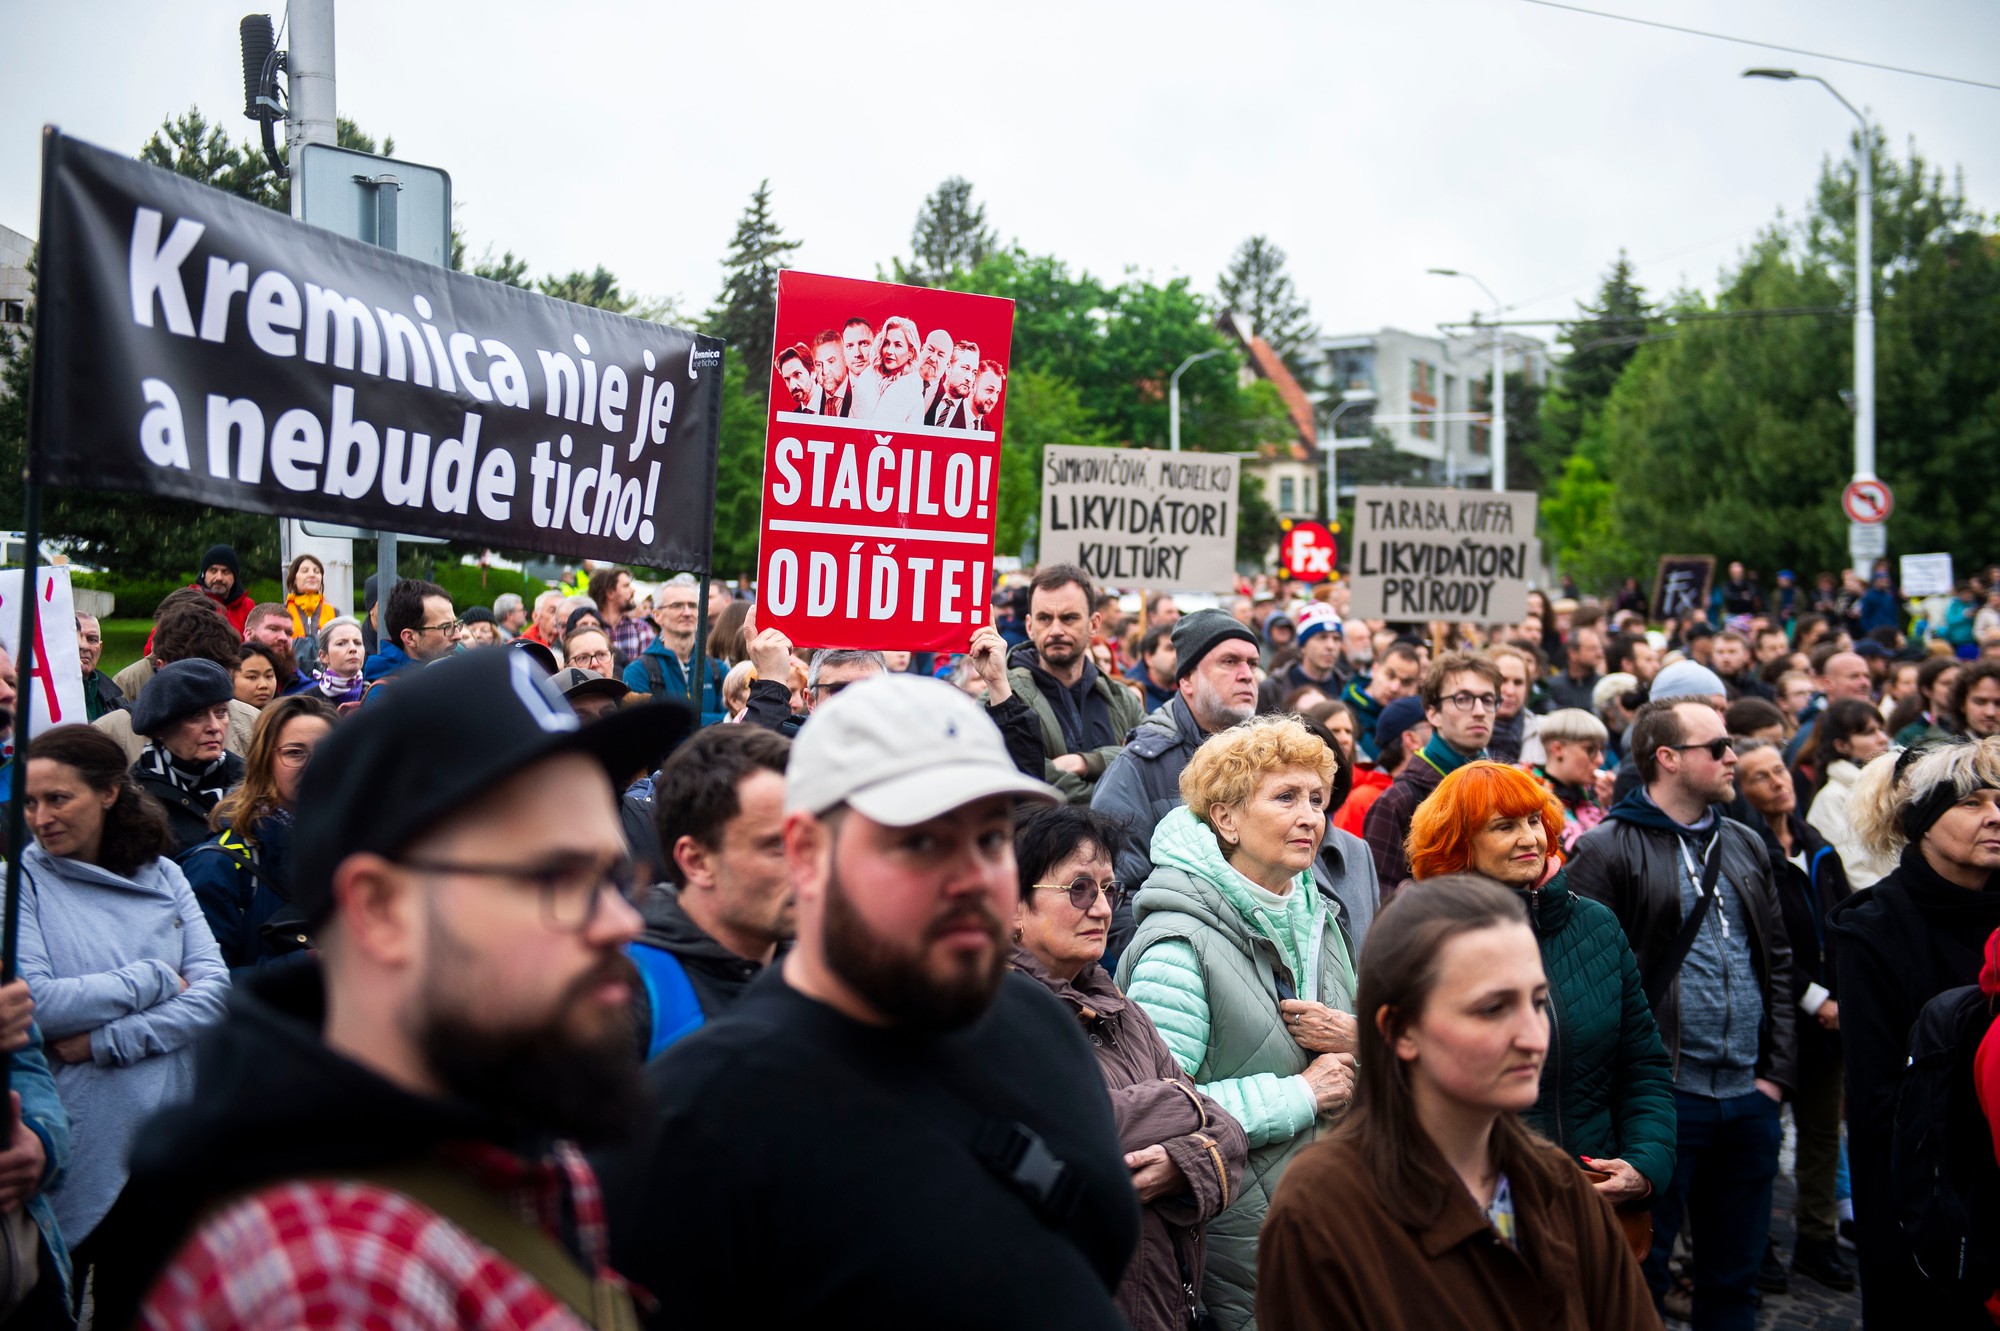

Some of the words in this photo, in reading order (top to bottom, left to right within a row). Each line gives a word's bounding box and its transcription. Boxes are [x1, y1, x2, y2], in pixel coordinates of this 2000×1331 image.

[129, 207, 530, 411] Kremnica
[536, 333, 630, 433] nie
[630, 349, 676, 462] je
[140, 378, 191, 470] a
[206, 384, 517, 521] nebude
[530, 433, 660, 545] ticho!
[772, 434, 993, 519] STAČILO!
[1159, 461, 1231, 492] MICHELKO
[1051, 494, 1227, 537] LIKVIDÁTORI
[1079, 537, 1188, 581] KULTÚRY
[1292, 530, 1332, 573] Fx
[1360, 537, 1527, 580] LIKVIDÁTORI
[767, 541, 985, 625] ODÍĎTE!
[1382, 571, 1495, 617] PRÍRODY
